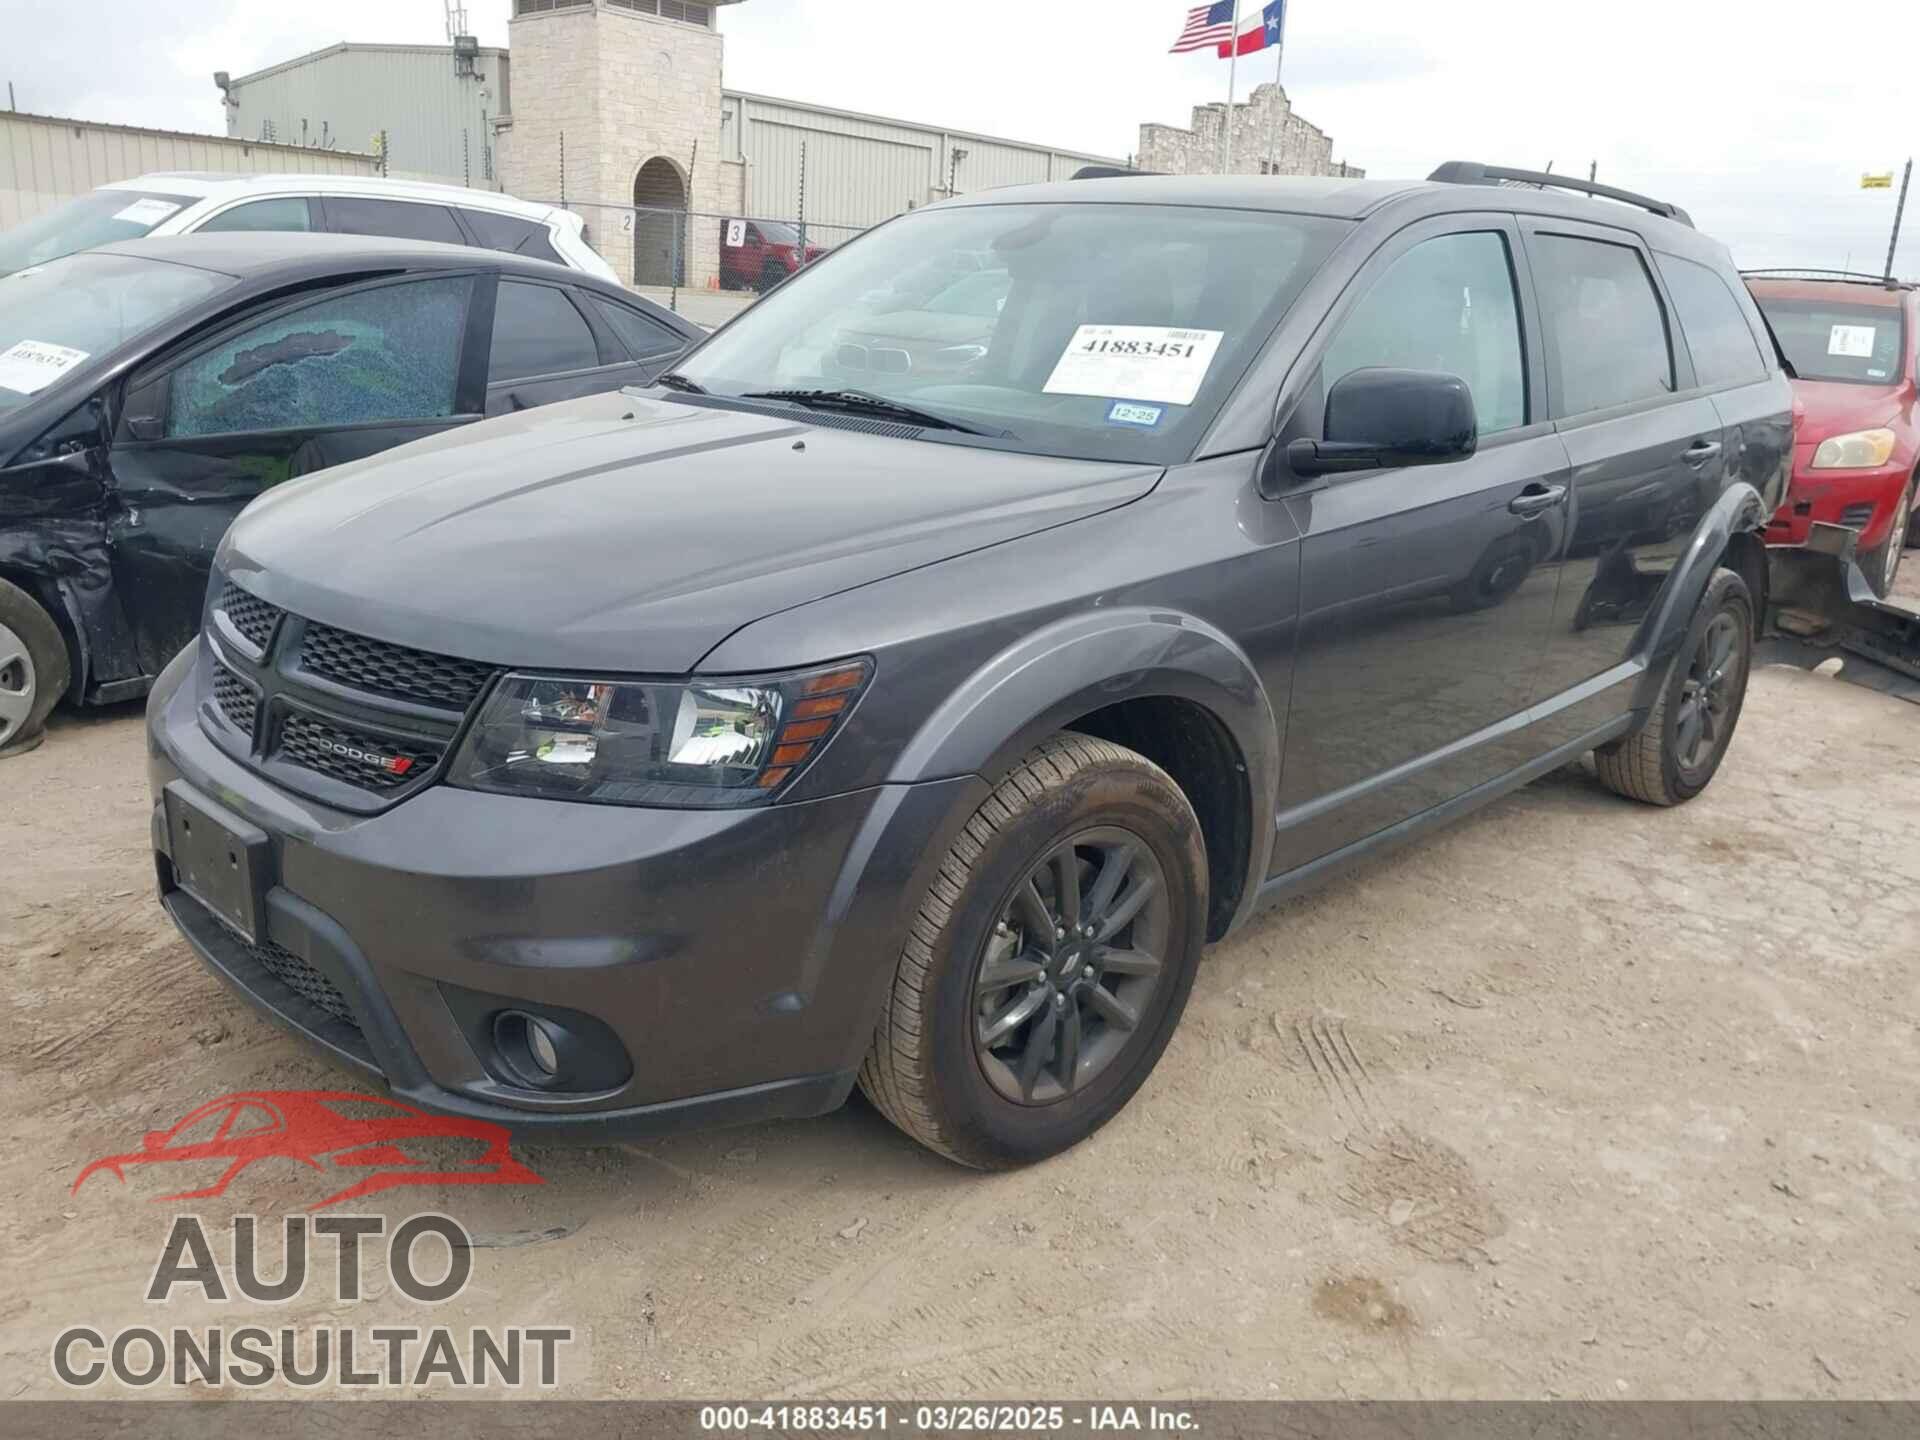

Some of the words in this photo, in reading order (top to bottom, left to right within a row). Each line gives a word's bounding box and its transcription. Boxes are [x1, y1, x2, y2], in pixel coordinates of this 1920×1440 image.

[623, 215, 631, 231] 2
[732, 224, 741, 242] 3
[1081, 338, 1195, 359] 41883451
[319, 738, 396, 769] DODGE
